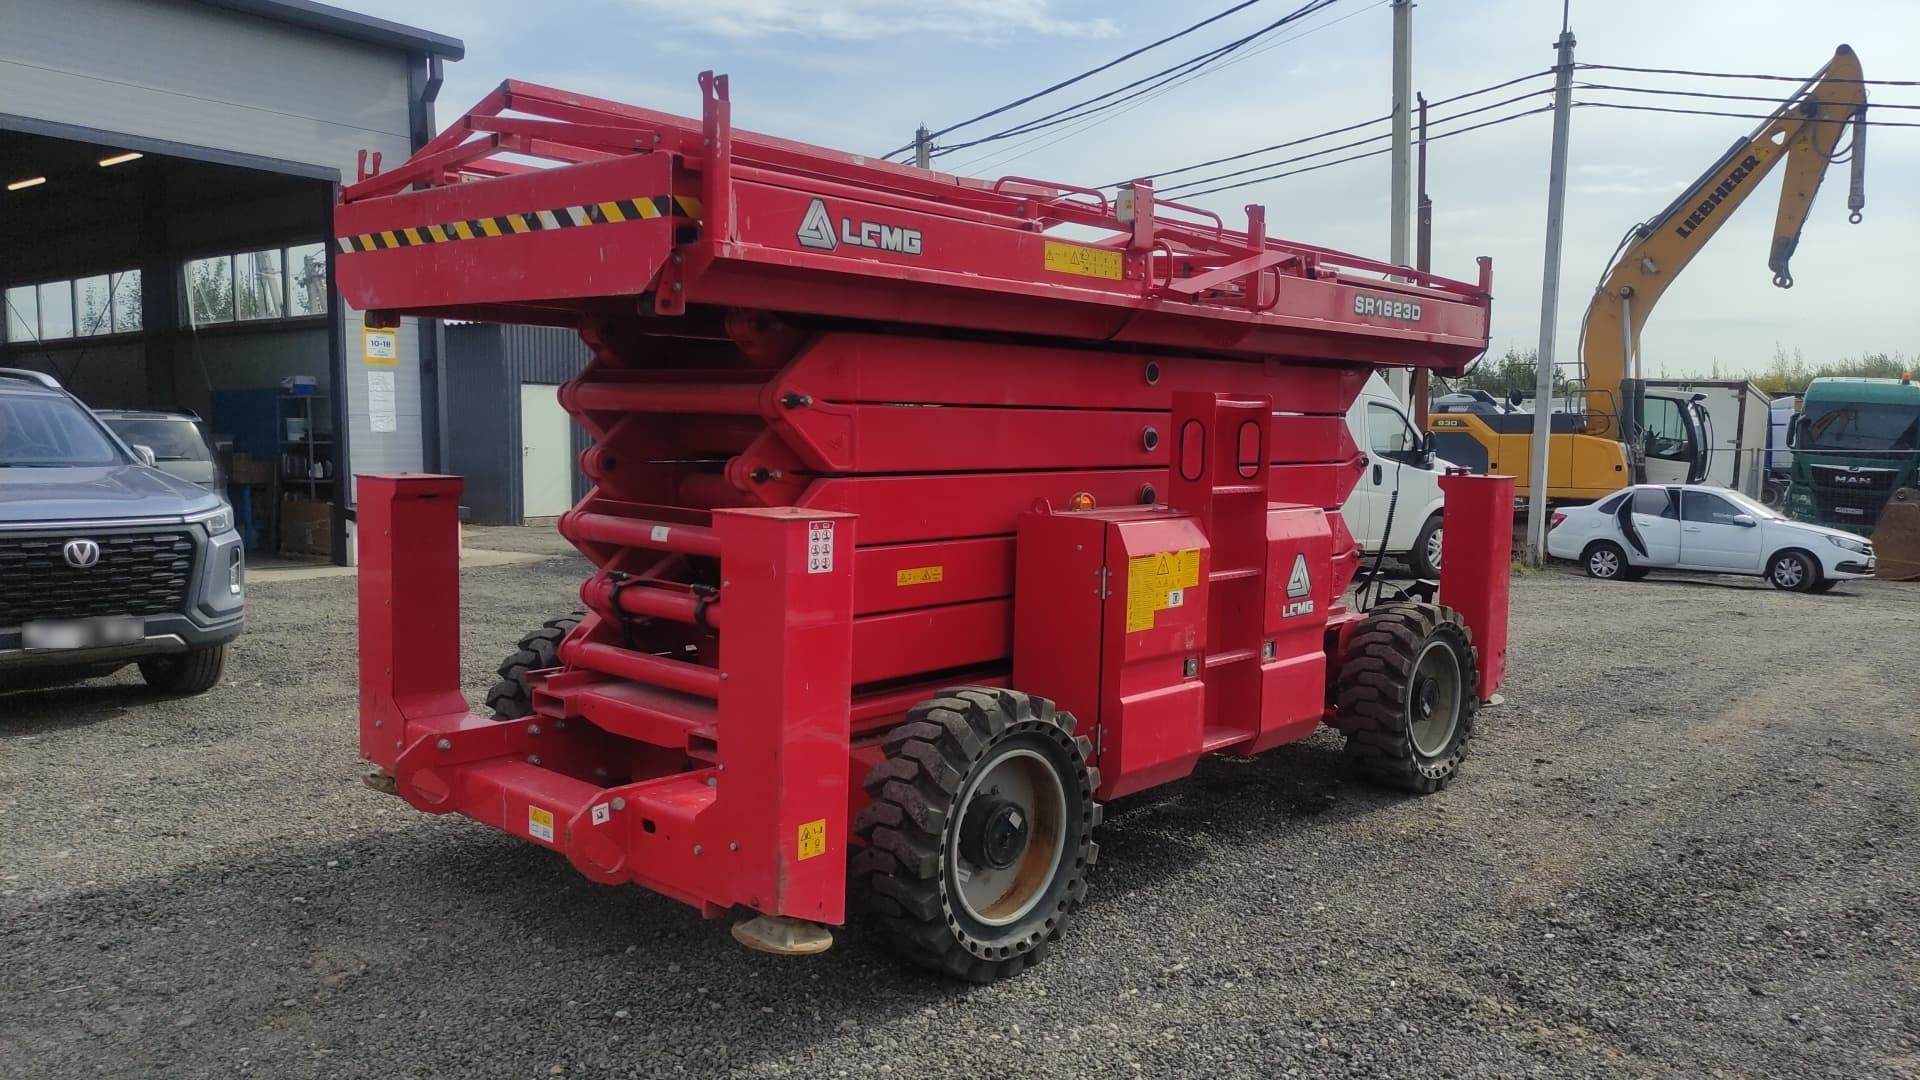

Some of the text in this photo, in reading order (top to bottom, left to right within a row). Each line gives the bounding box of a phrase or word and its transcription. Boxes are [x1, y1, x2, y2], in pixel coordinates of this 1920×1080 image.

[1675, 155, 1760, 239] LIEBHERR
[1354, 295, 1421, 321] SR1623D
[1835, 475, 1872, 484] MAN
